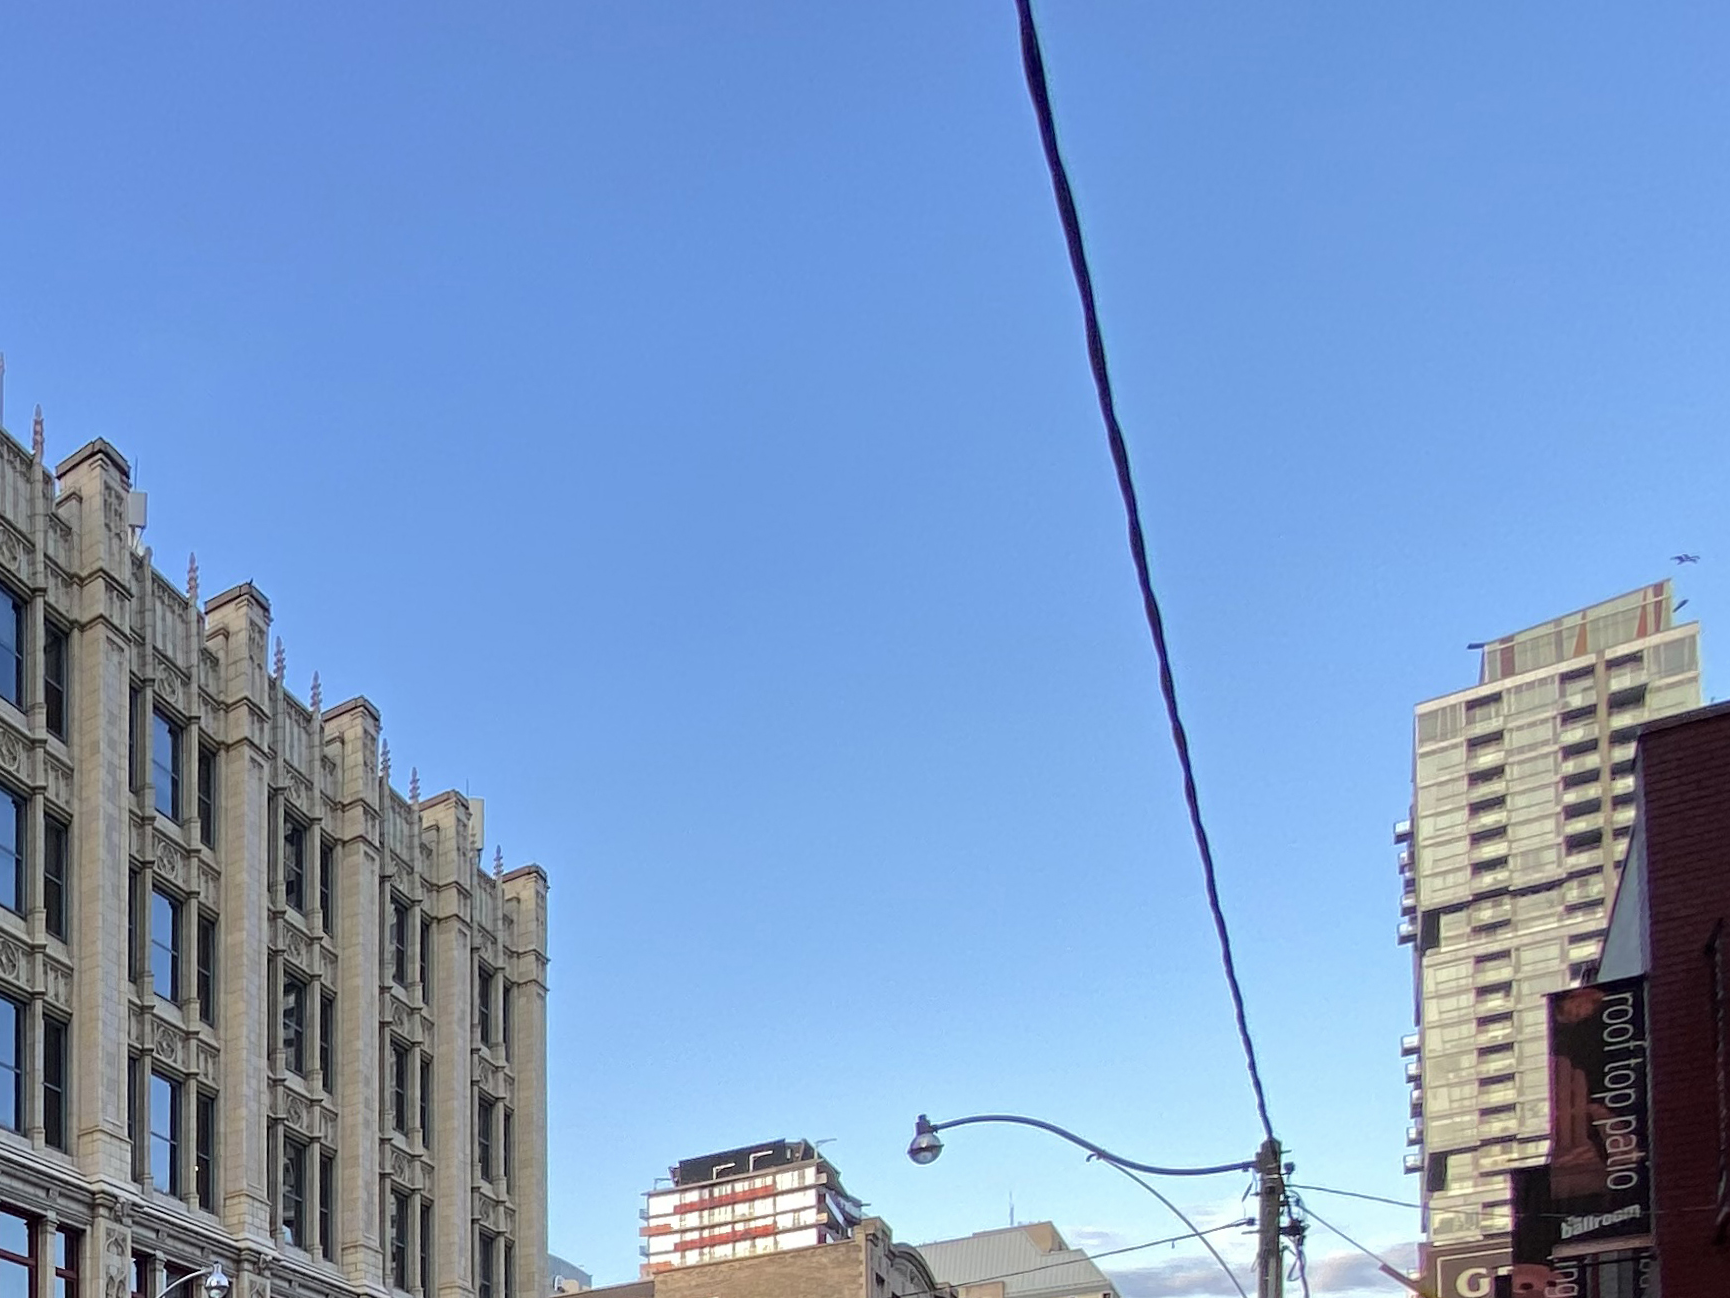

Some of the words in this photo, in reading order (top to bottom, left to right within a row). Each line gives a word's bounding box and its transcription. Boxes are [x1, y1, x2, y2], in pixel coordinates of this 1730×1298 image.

[1602, 991, 1648, 1051] roof
[1591, 1058, 1644, 1108] top
[1592, 1115, 1648, 1190] patio
[1560, 1204, 1642, 1239] ballroom
